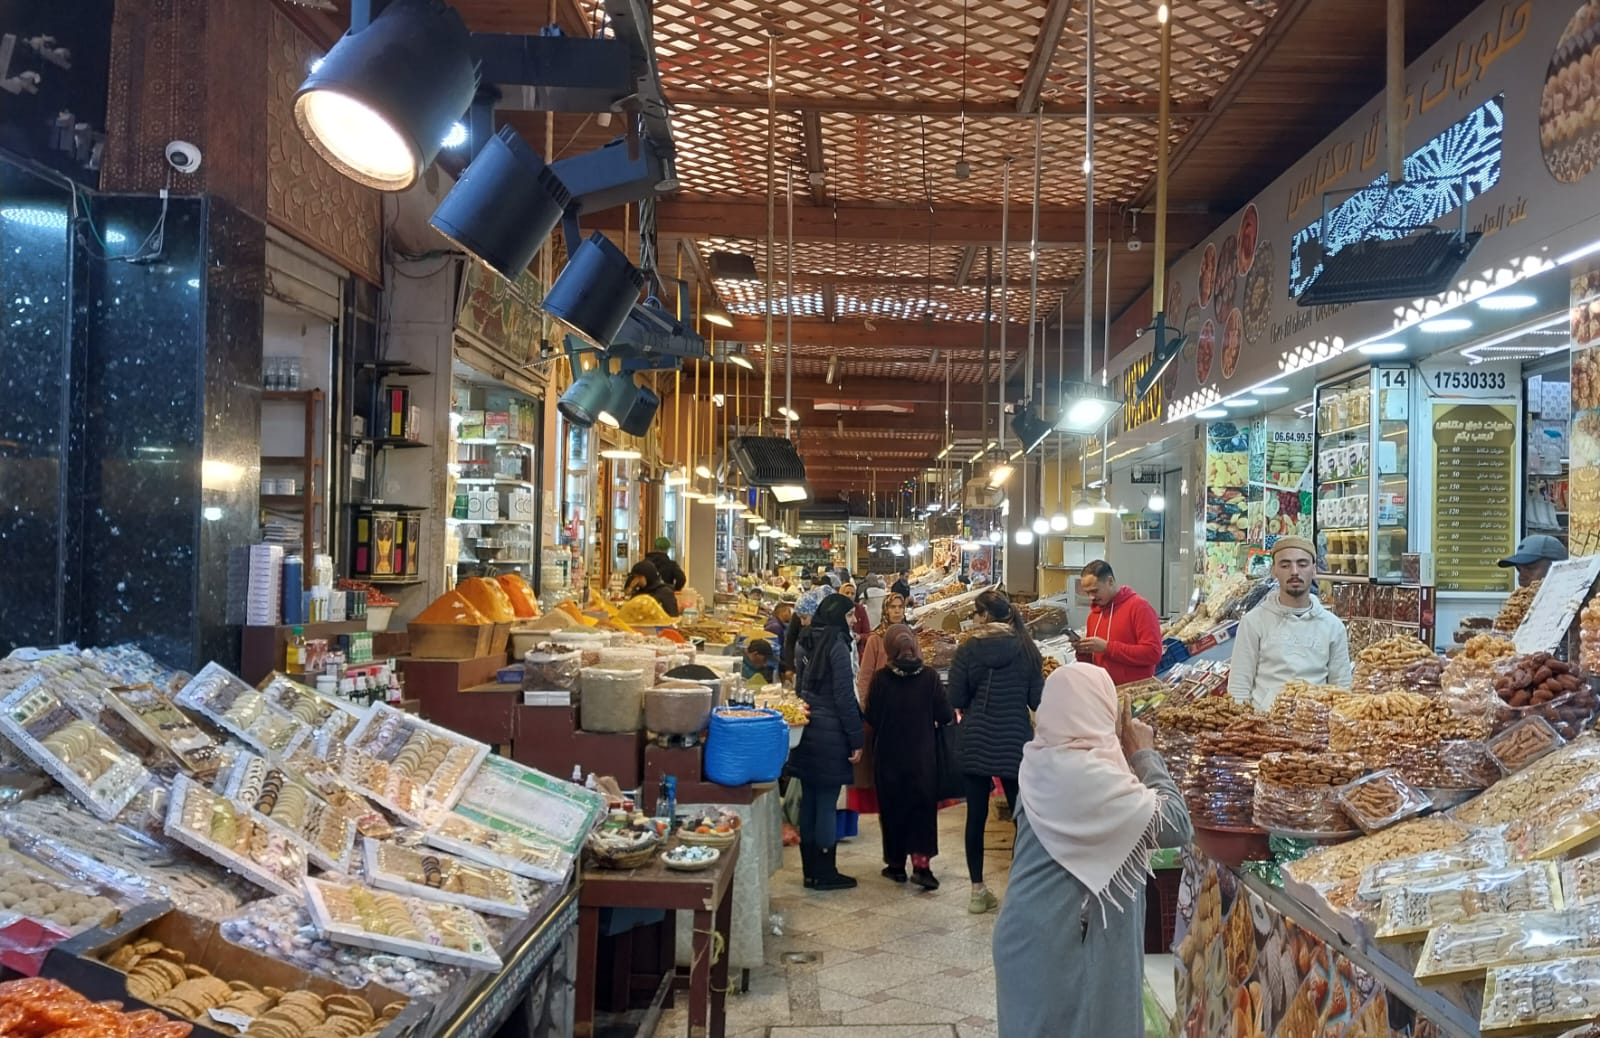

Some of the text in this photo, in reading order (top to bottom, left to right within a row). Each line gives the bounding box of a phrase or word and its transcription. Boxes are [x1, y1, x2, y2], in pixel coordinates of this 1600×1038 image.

[1419, 1, 1532, 115] حلويات
[1287, 141, 1355, 224] مكناس
[1381, 370, 1407, 388] 14
[1434, 371, 1506, 389] 17530333
